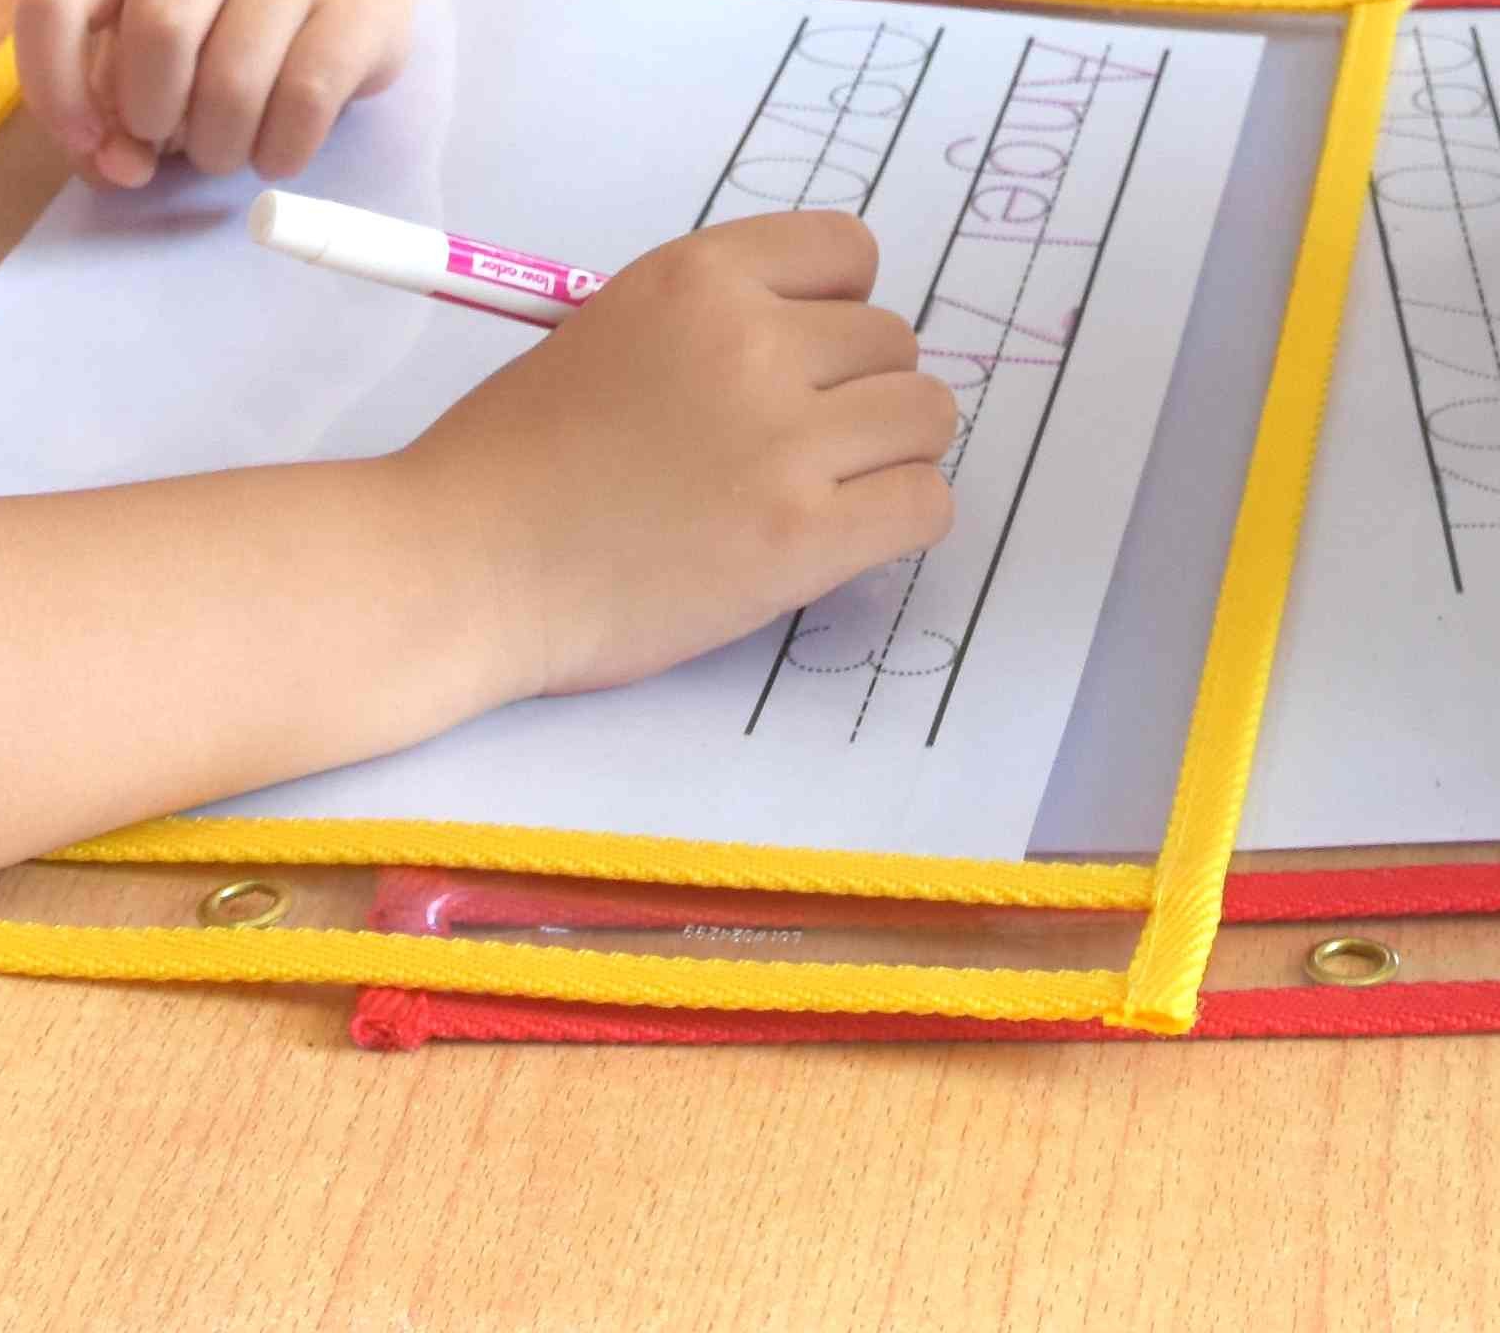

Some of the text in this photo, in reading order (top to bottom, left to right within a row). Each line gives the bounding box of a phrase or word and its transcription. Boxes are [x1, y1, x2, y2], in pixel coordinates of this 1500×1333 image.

[944, 39, 1159, 248] Angel
[481, 260, 518, 278] odor
[522, 270, 550, 291] low
